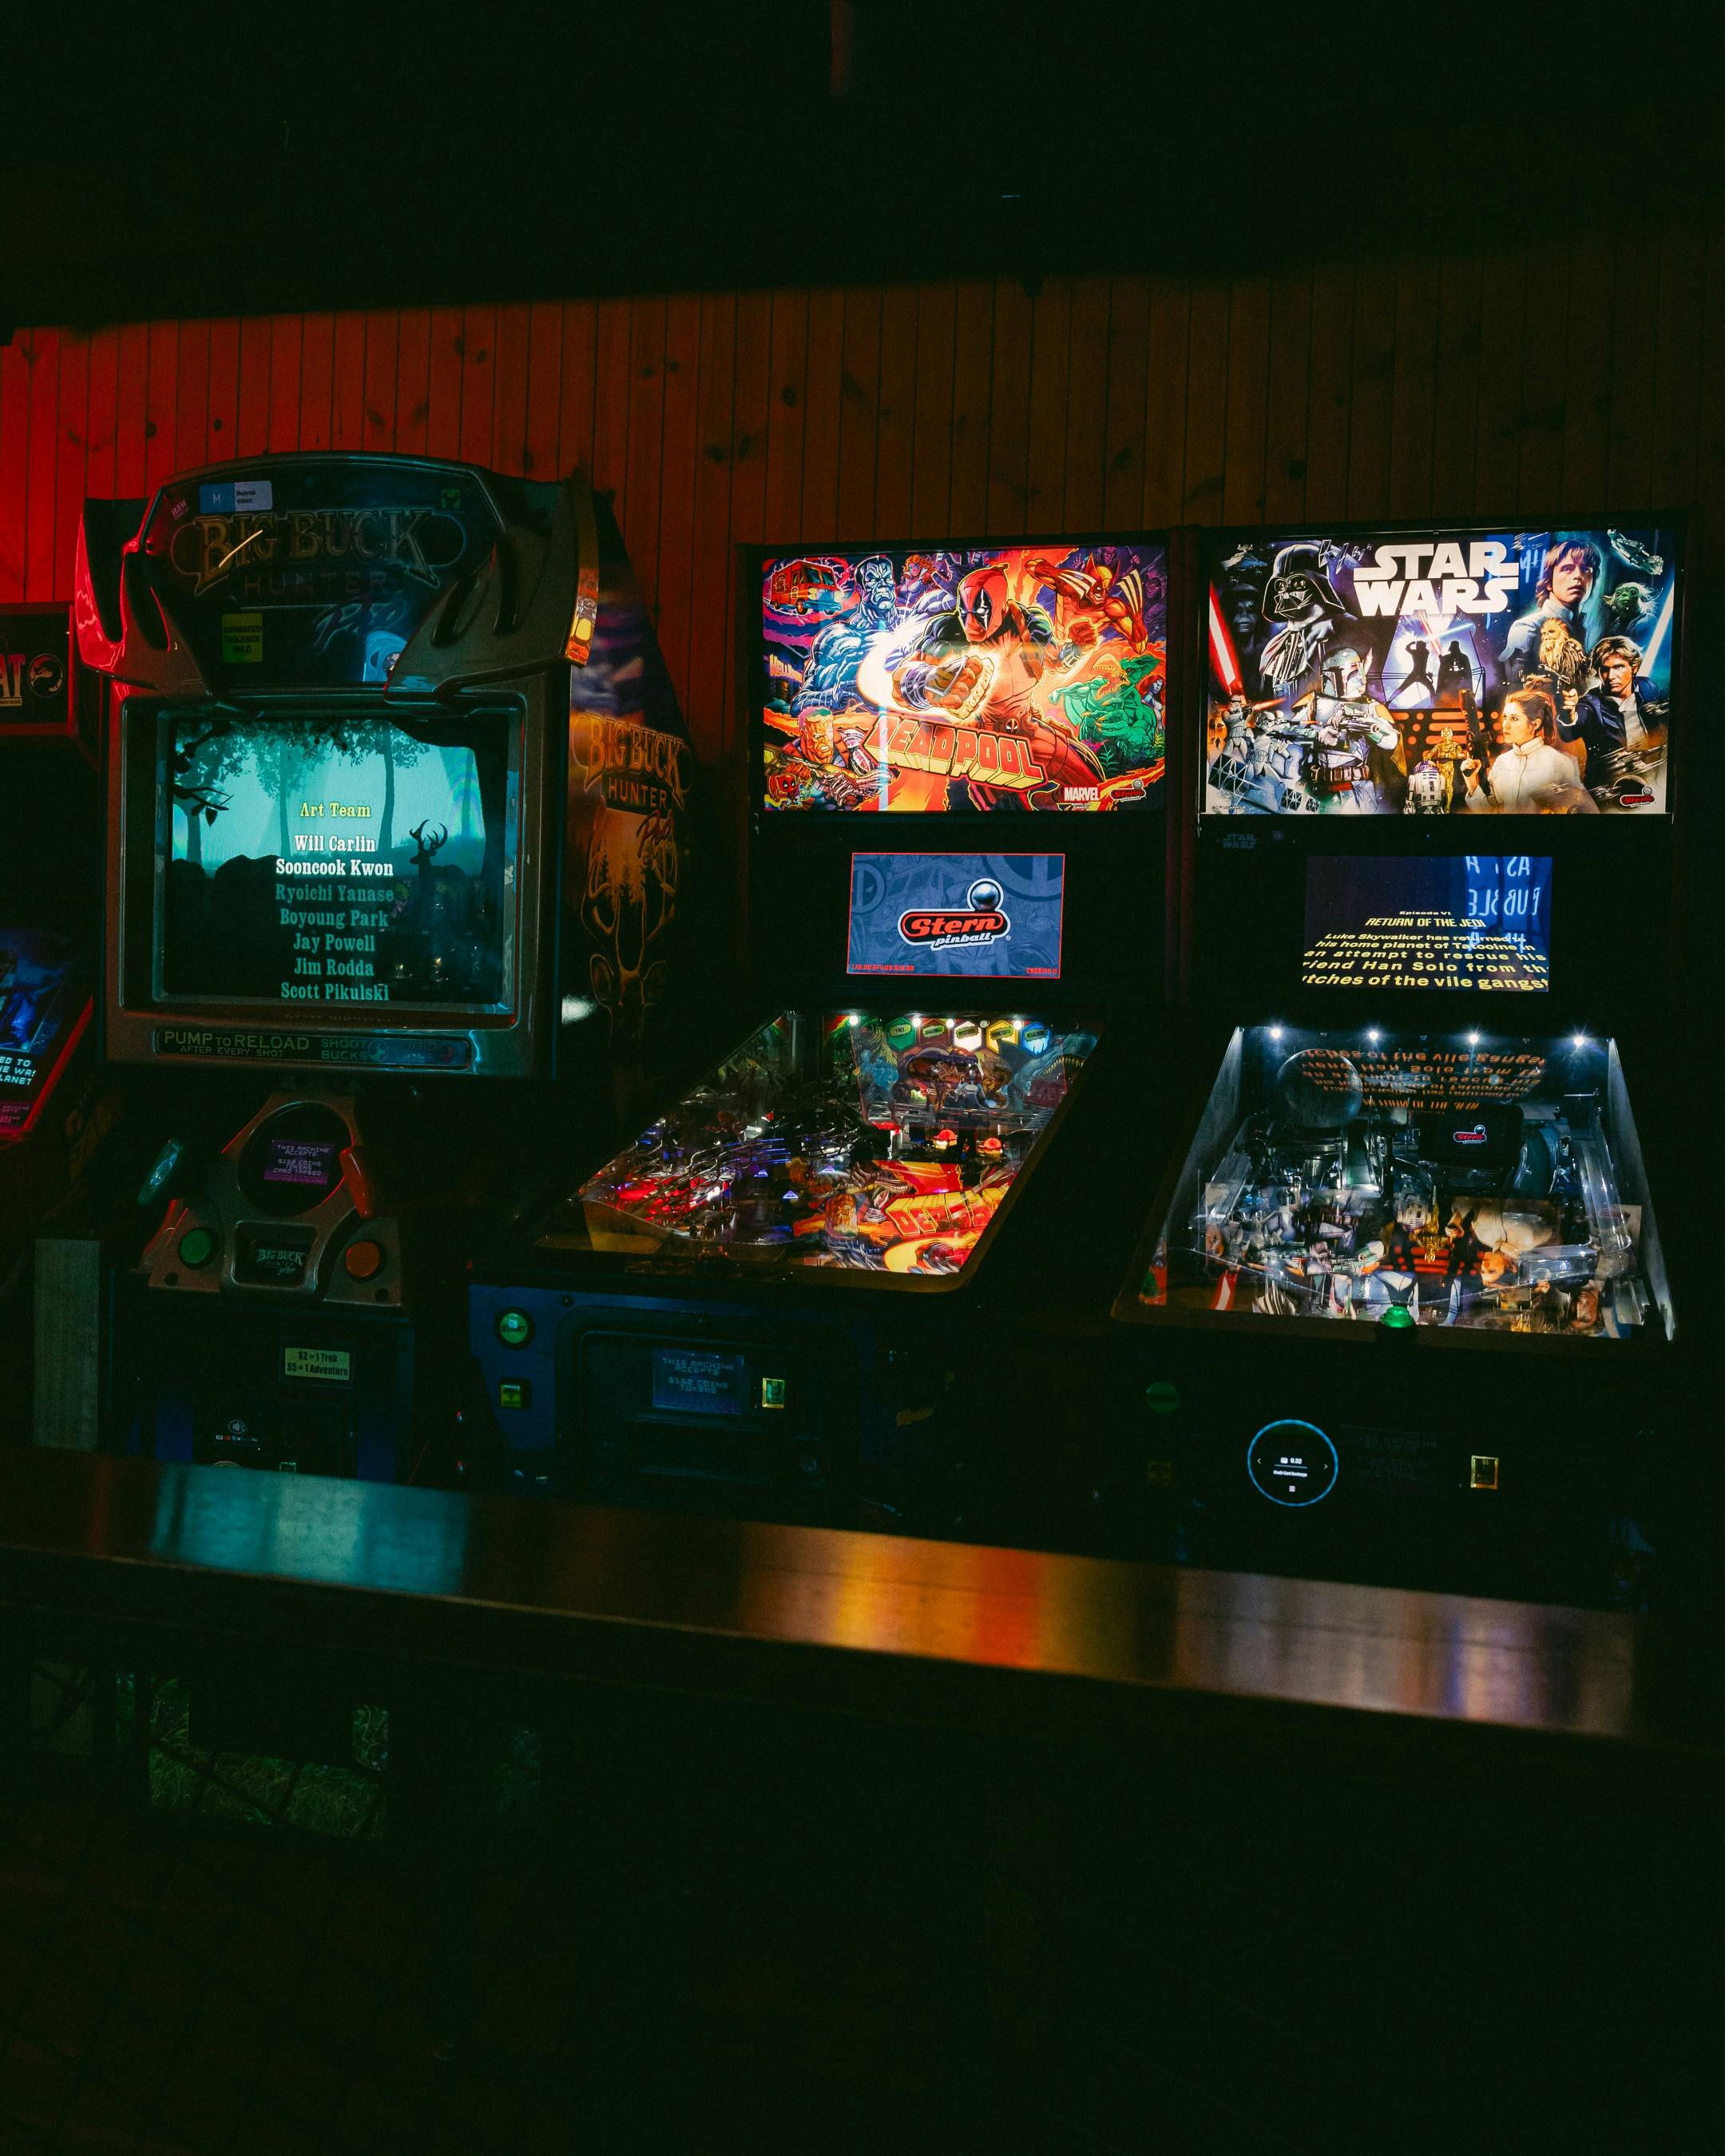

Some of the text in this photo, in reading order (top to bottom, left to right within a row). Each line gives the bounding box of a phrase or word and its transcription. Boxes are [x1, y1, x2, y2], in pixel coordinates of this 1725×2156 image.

[212, 493, 220, 504] M
[194, 509, 440, 596] BIG BUCK
[1354, 541, 1519, 581] STAR
[244, 571, 387, 596] HUNTER
[1354, 577, 1519, 616] WARS
[585, 711, 684, 810] BIG BUCK
[866, 716, 1045, 789] DEADPOOL
[608, 778, 667, 809] HUNTER
[1064, 787, 1100, 801] MARVEL
[299, 801, 371, 818] Art Team
[294, 834, 376, 852] Will Carlin
[276, 858, 394, 876] Sooncook Kwon
[276, 884, 394, 903] Ryoichi Yanase
[280, 908, 389, 929] Boyoung Park
[911, 917, 997, 937] Stern
[1365, 917, 1487, 928] RETURN OF THE JEDI
[293, 933, 376, 953] Jay Powell
[934, 932, 993, 946] pinball
[1333, 950, 1408, 960] attempt
[1515, 953, 1547, 961] his
[294, 957, 375, 977] Jim Rodda
[1362, 961, 1403, 970] Han
[1412, 961, 1457, 972] Solo
[1466, 963, 1517, 973] from
[1522, 964, 1549, 973] th
[1303, 973, 1364, 985] tches
[1368, 974, 1391, 986] of
[1394, 975, 1430, 986] the
[1434, 976, 1473, 988] vile
[281, 981, 390, 1001] Scott Pikulski
[165, 1031, 310, 1050] PUMP TO RELOAD
[321, 1039, 367, 1048] SHOOT
[256, 1049, 284, 1058] SHOT
[321, 1050, 367, 1060] BUCKS
[17, 1058, 32, 1067] TO
[256, 1249, 305, 1266] BIG BUCK
[298, 1351, 308, 1361] $2
[319, 1353, 338, 1362] Trek
[662, 1357, 735, 1371] THIS MACHINE
[287, 1362, 297, 1372] $5
[309, 1365, 349, 1376] Adventure
[676, 1365, 720, 1376] ACCEPTS
[680, 1384, 717, 1394] TOKENS
[696, 1379, 728, 1389] COINS
